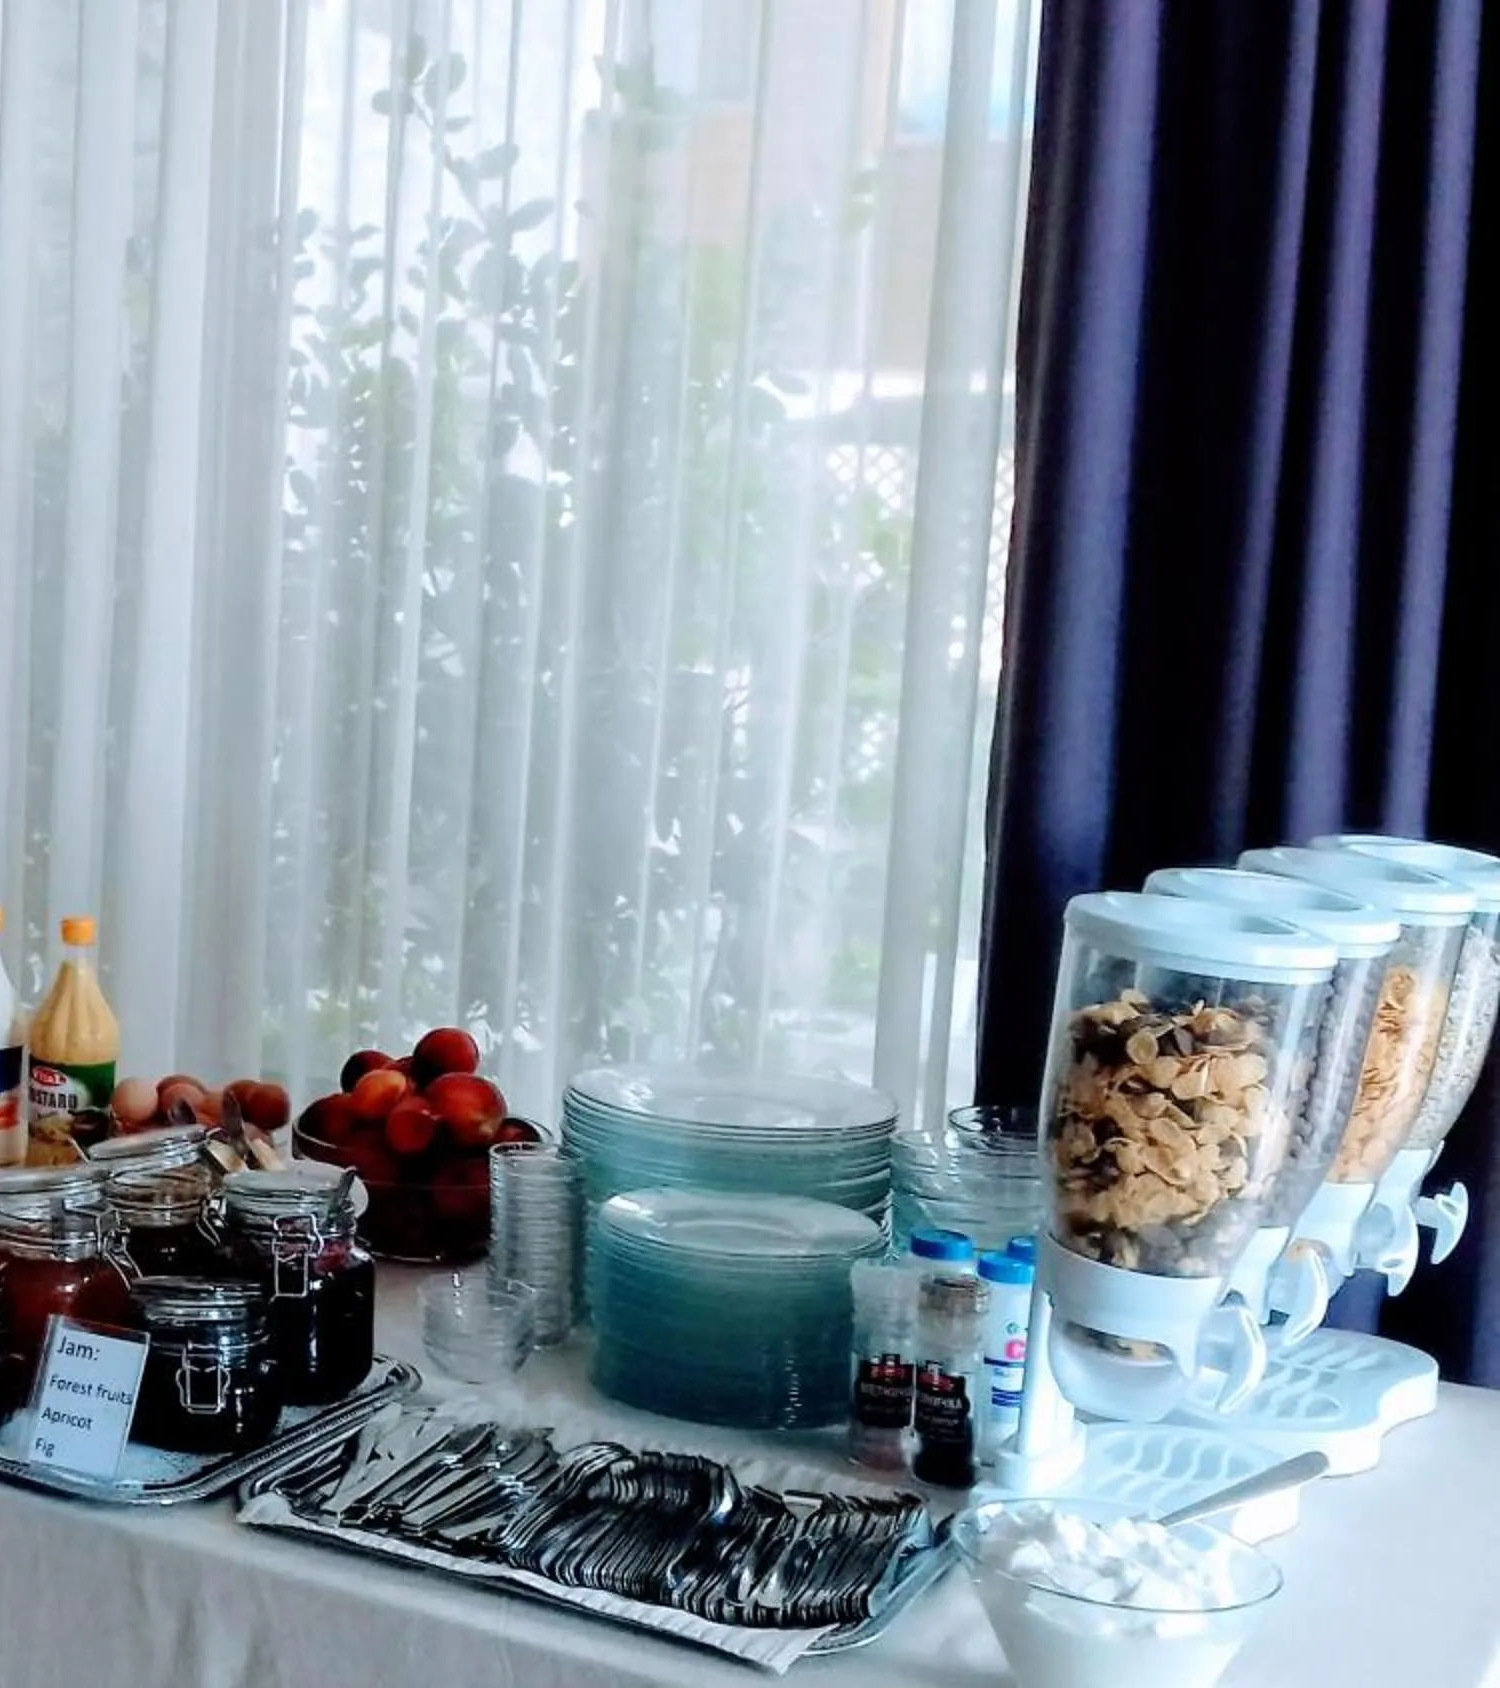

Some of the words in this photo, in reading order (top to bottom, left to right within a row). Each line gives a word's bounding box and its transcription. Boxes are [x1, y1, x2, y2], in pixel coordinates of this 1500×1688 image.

[56, 1335, 100, 1361] Jam:
[49, 1374, 93, 1397] Forest
[95, 1383, 133, 1405] fruits
[41, 1406, 94, 1431] Apricot
[35, 1437, 56, 1458] Fig
